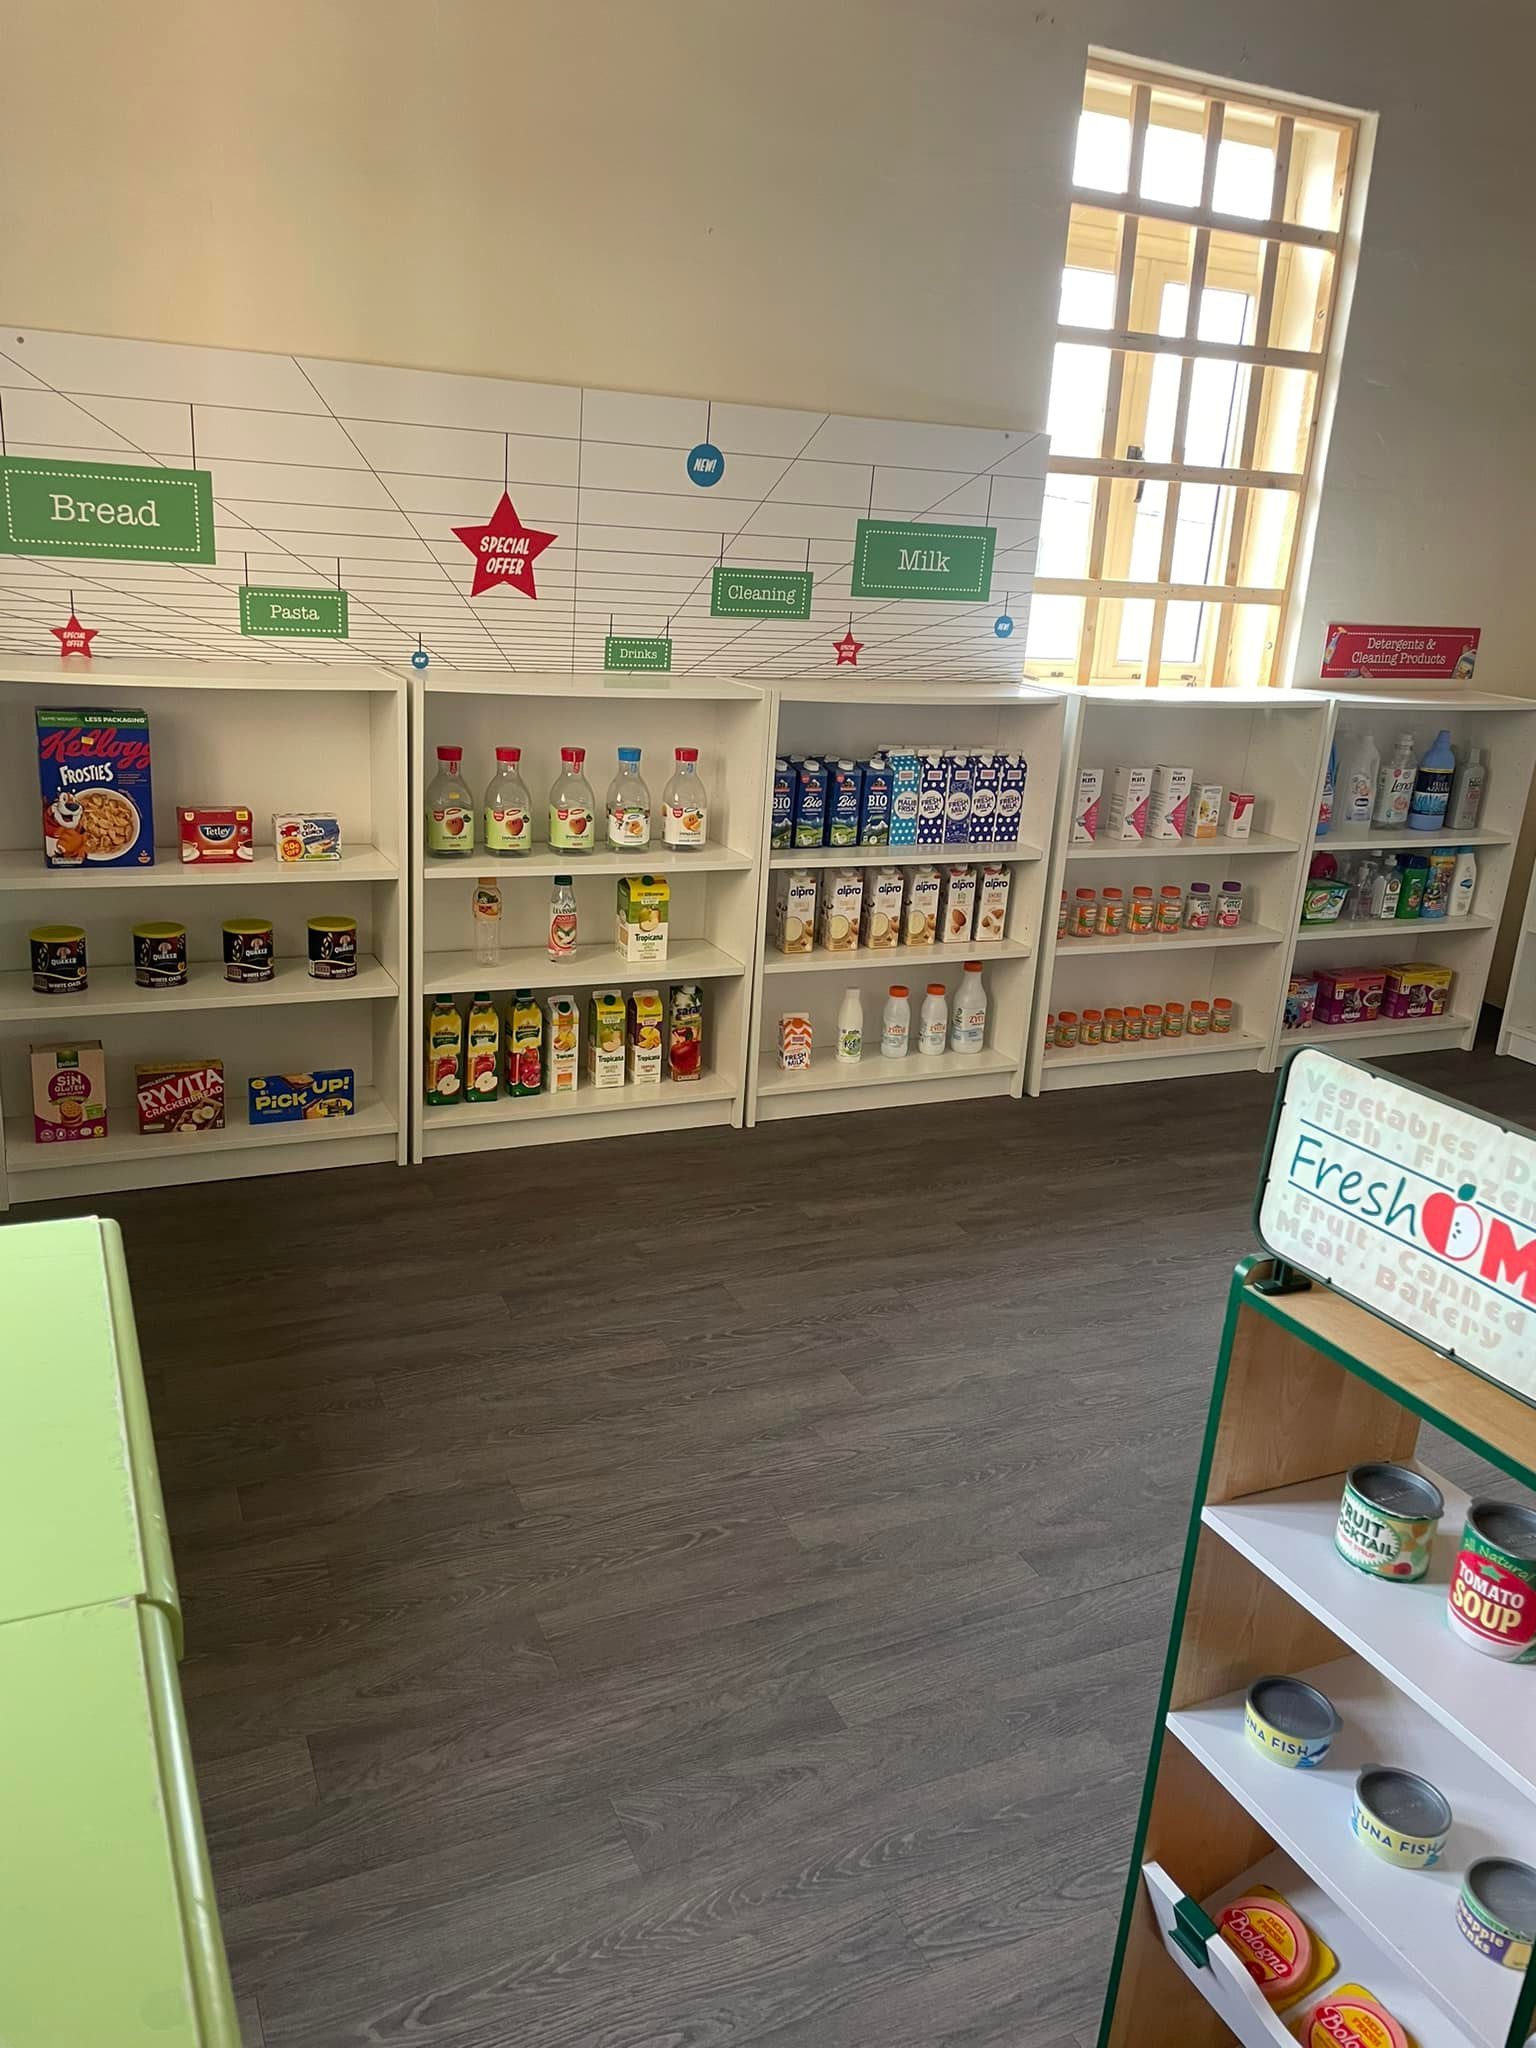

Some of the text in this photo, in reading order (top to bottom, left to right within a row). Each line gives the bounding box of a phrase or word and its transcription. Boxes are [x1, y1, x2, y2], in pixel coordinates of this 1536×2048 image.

[693, 457, 717, 473] NEW!
[49, 494, 160, 528] Bread
[480, 535, 530, 555] SPECIAL
[485, 557, 525, 575] OFFER
[897, 548, 951, 573] Milk
[728, 584, 797, 605] Cleaning
[269, 604, 320, 621] Pasta
[1367, 637, 1437, 652] Detergents &
[619, 649, 658, 659] Drinks
[1351, 651, 1446, 666] Cleaning Products
[59, 762, 114, 786] FROSTIES
[802, 796, 823, 808] Bio
[837, 795, 857, 807] Bio
[868, 795, 888, 806] BIO
[204, 825, 231, 838] Tetley
[790, 886, 815, 899] alpro
[837, 885, 861, 897] alpro
[879, 883, 901, 895] alpro
[915, 881, 938, 893] alpro
[952, 879, 975, 891] alpro
[985, 878, 1008, 890] alpro
[635, 933, 664, 942] Tropicana
[598, 1055, 624, 1063] Tropicana
[137, 1068, 224, 1111] RYVITA
[312, 1077, 350, 1094] UP!
[1304, 1068, 1477, 1161] Vegetables
[1314, 1102, 1536, 1228] Fish Frozen
[1289, 1134, 1536, 1306] Fresh M
[1292, 1196, 1527, 1337] Fruit Canned
[1274, 1210, 1502, 1349] Meat Bakery
[1480, 1544, 1535, 1582] Natural
[1459, 1560, 1525, 1609] TOMATO
[1453, 1578, 1522, 1634] SOUP
[1271, 1737, 1309, 1756] FISH
[1356, 1806, 1438, 1855] TUNA FISH
[1229, 1909, 1289, 1975] Bologna
[1320, 2006, 1367, 2048] Bolo
